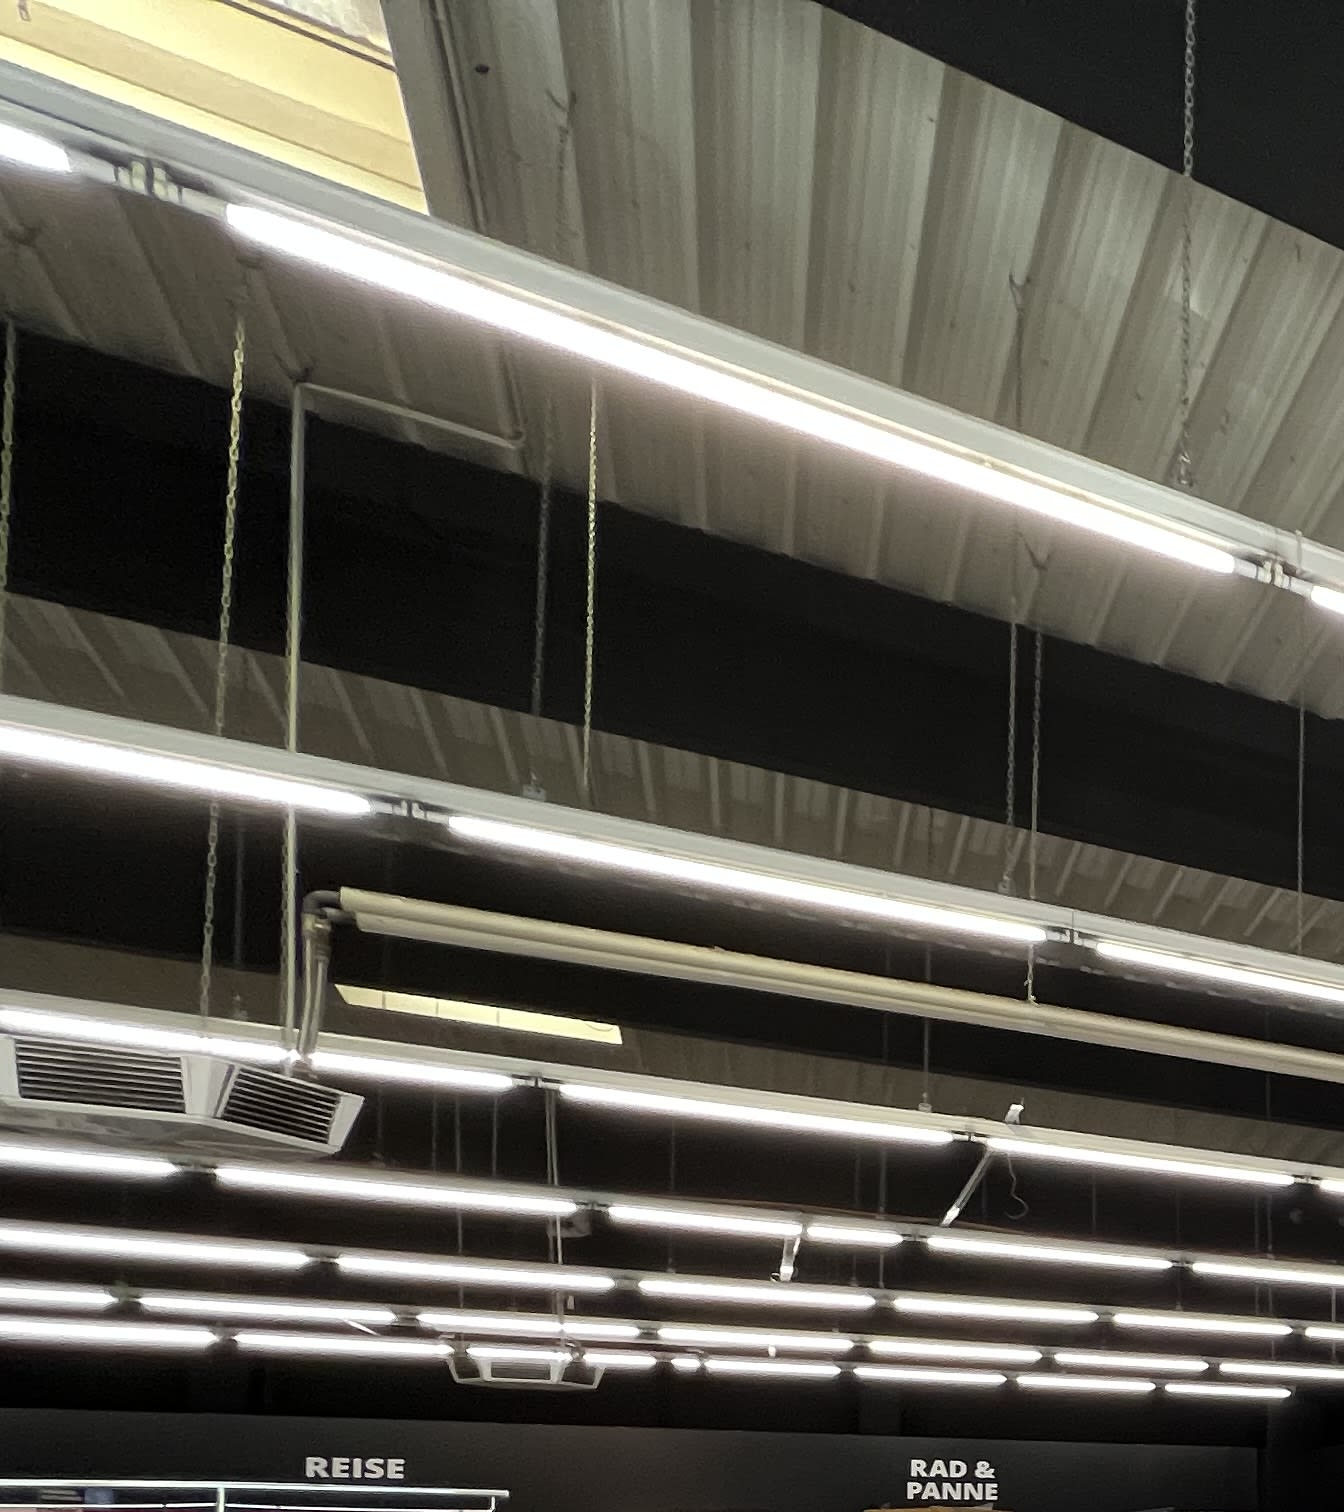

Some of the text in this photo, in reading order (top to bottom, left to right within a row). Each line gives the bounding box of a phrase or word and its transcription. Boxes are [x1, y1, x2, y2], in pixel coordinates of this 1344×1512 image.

[305, 1456, 406, 1479] REISE
[910, 1459, 996, 1479] RAD &
[906, 1481, 999, 1501] PANNE
